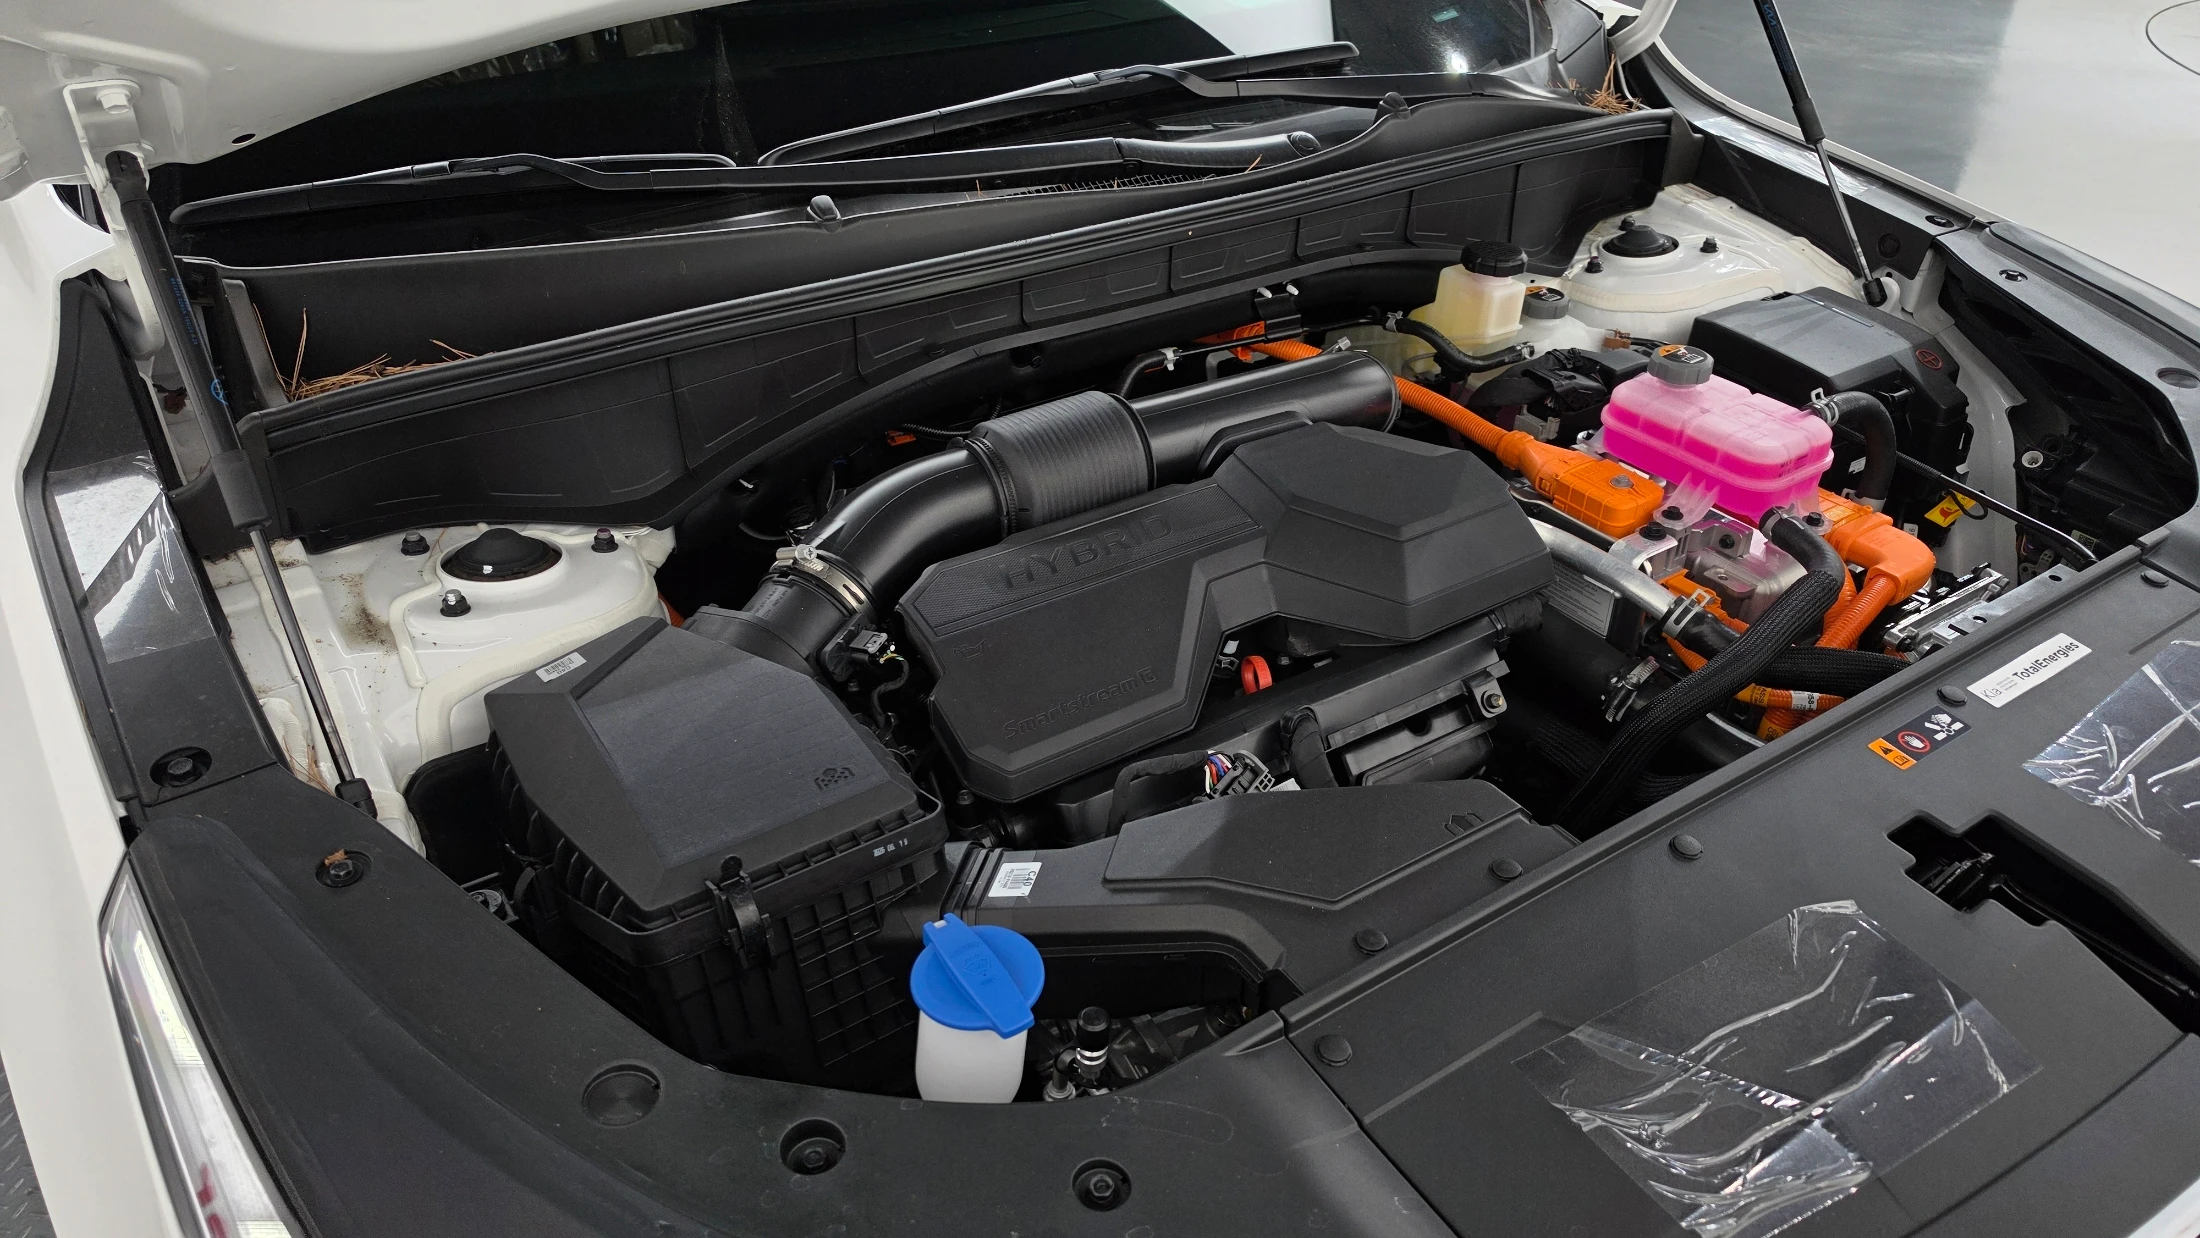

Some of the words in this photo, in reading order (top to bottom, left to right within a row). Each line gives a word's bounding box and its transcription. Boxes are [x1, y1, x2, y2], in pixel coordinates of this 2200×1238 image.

[1000, 514, 1172, 589] HYBRID
[2011, 642, 2080, 681] TotalEnergies
[1002, 677, 1137, 740] Smartstream
[1980, 686, 2002, 700] Kia
[1022, 870, 1037, 887] C40
